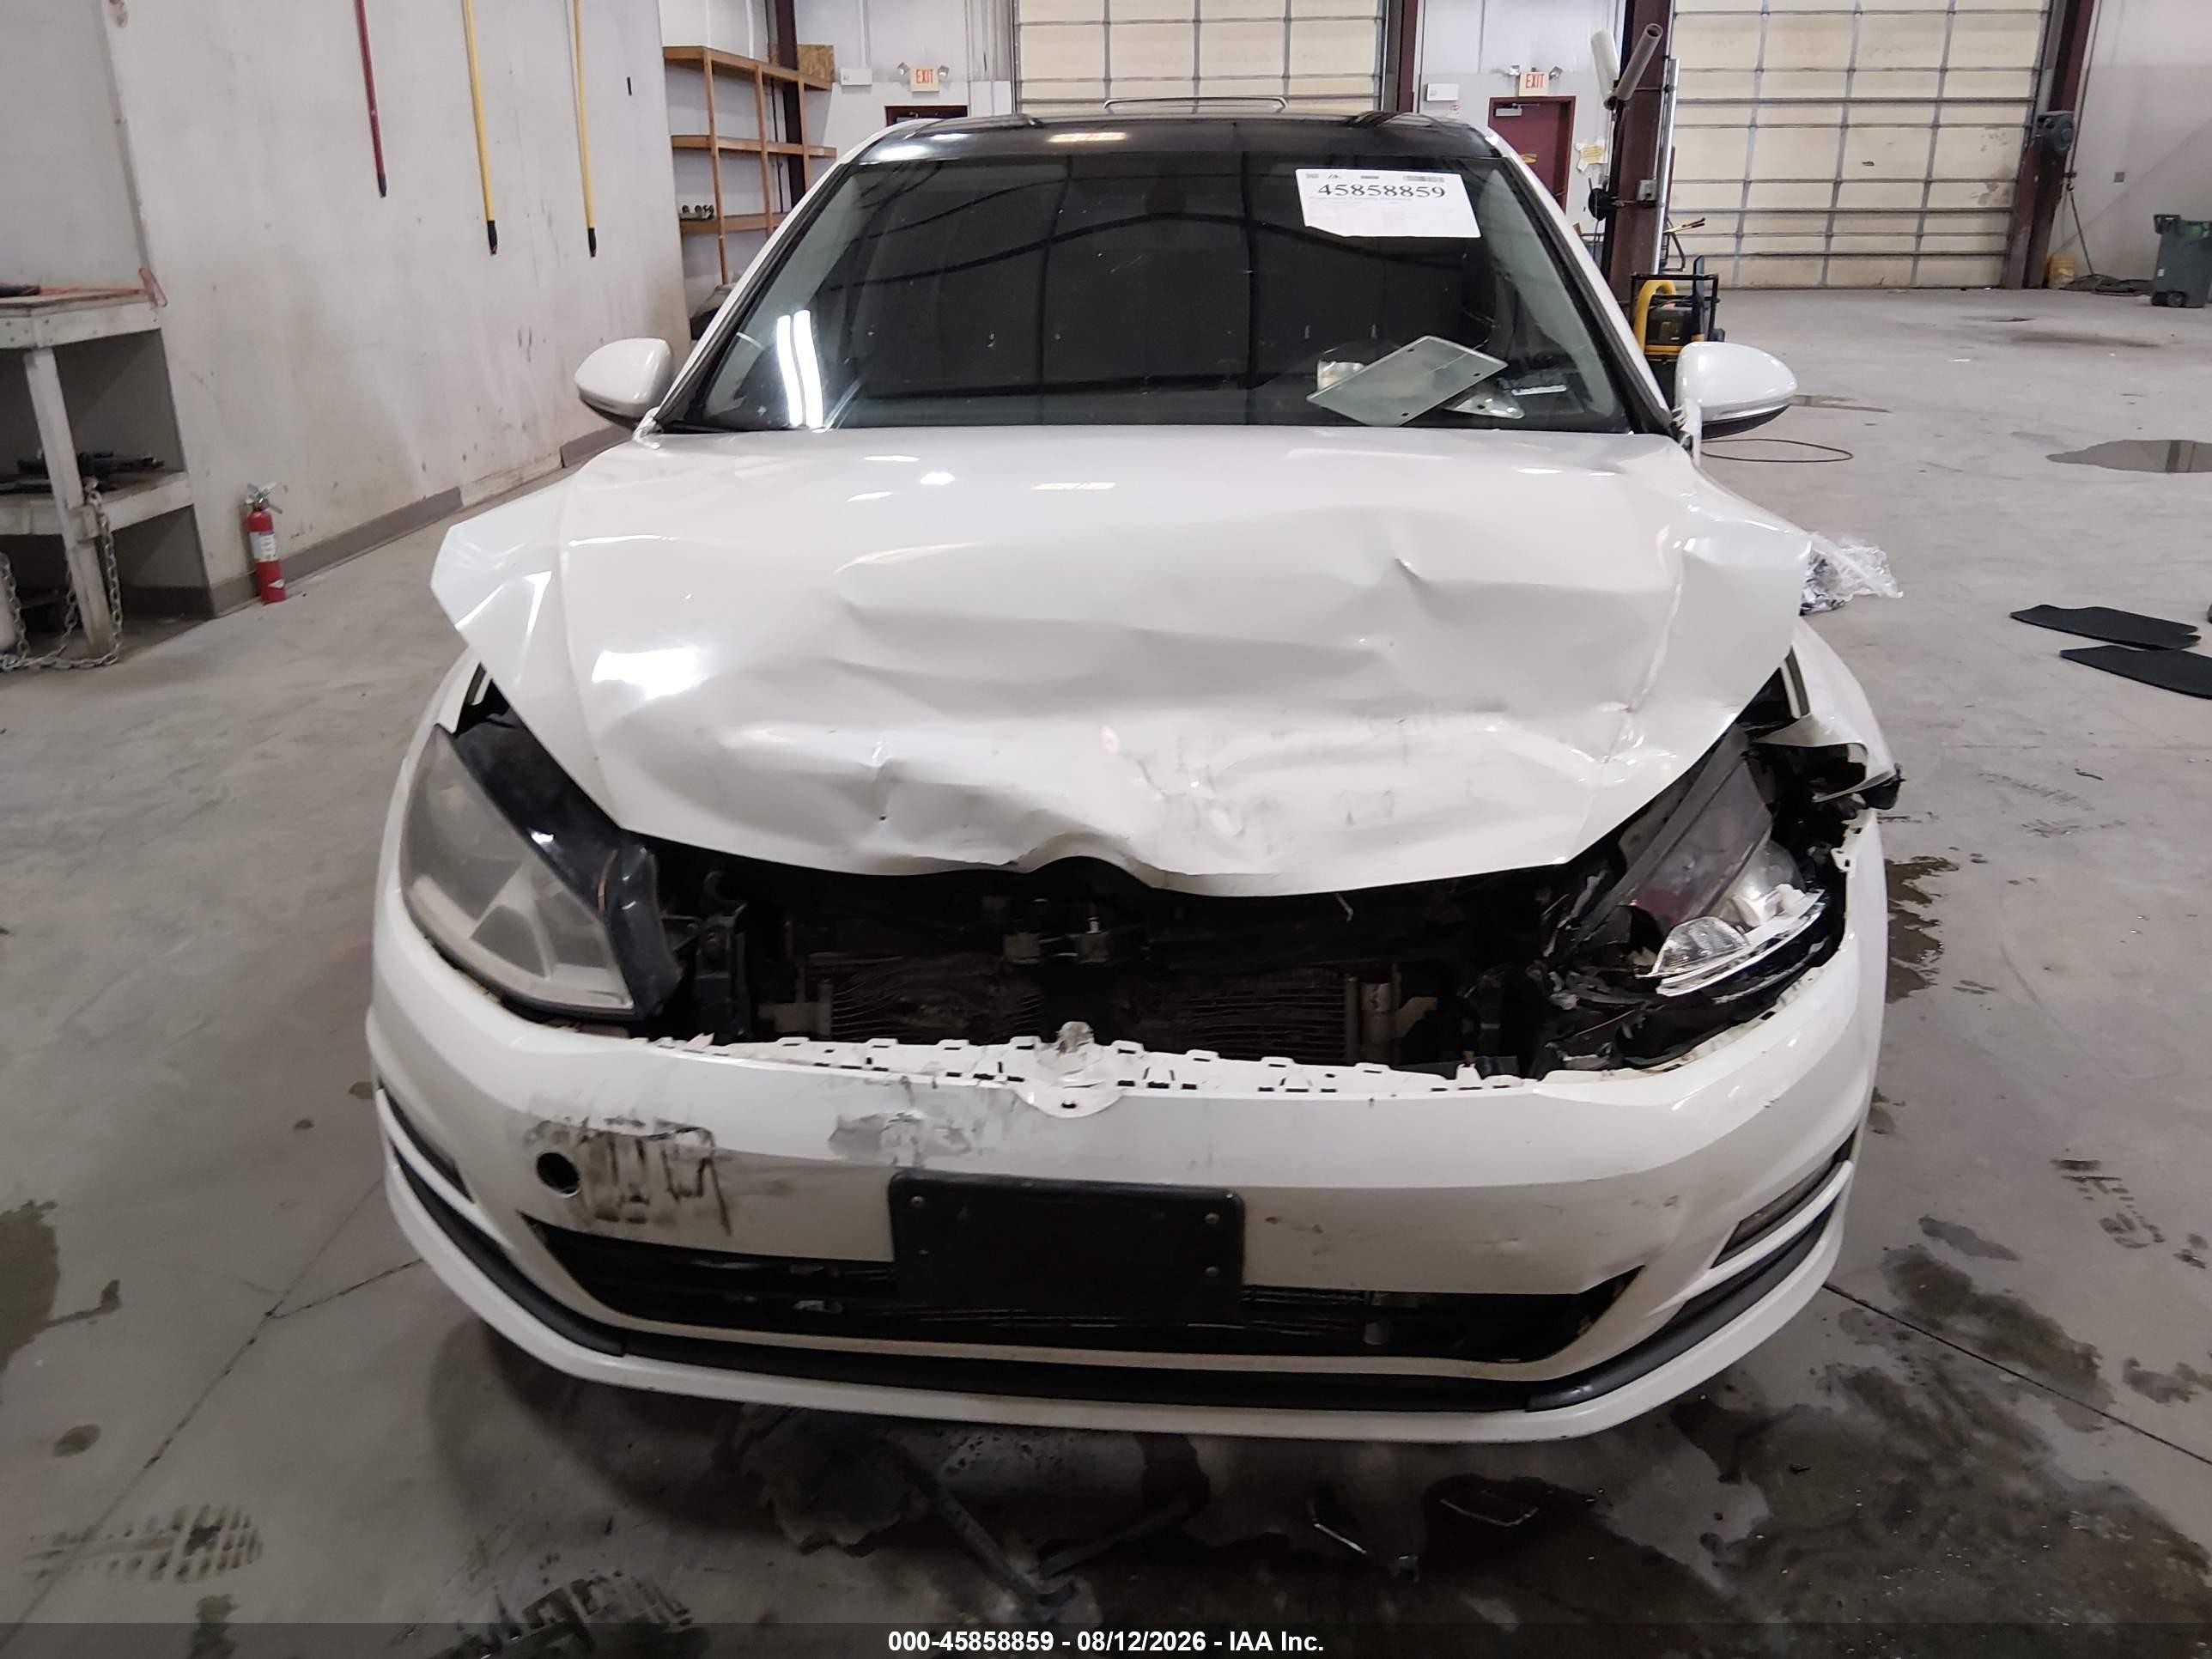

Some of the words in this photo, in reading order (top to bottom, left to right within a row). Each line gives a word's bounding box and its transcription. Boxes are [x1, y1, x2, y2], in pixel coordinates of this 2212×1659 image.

[915, 68, 934, 84] EXIT
[1525, 73, 1546, 89] EXIT
[1317, 183, 1447, 198] 45858859
